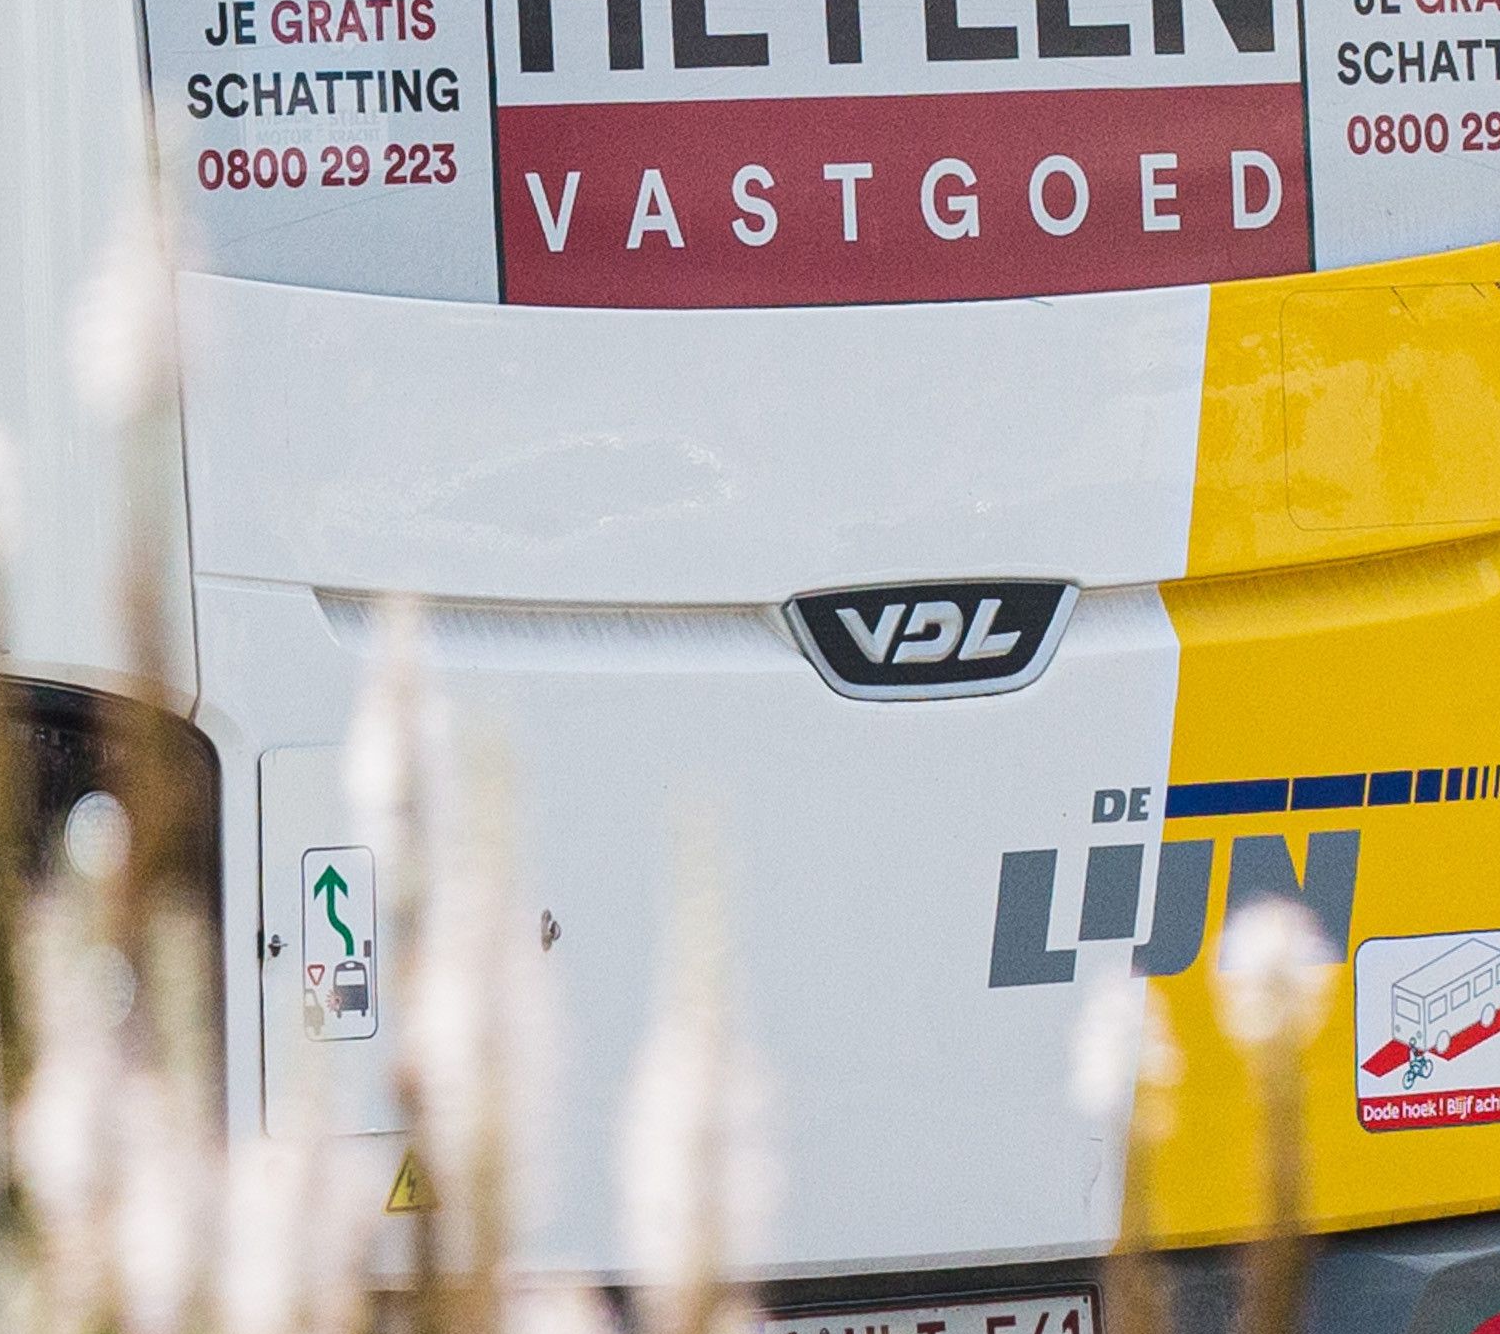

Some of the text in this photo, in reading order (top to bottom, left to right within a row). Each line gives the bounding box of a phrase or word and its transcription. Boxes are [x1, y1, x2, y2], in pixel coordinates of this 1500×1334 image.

[204, 1, 257, 47] JE
[187, 67, 460, 120] SCHATTING
[1347, 112, 1449, 156] 0800
[197, 143, 457, 191] 0800 29 223
[524, 150, 1283, 252] VASTGOED
[836, 596, 1022, 664] VDL
[1091, 786, 1152, 824] DE
[988, 829, 1361, 989] LIJN
[1363, 1102, 1400, 1122] Dode
[1446, 1095, 1475, 1120] Blijf
